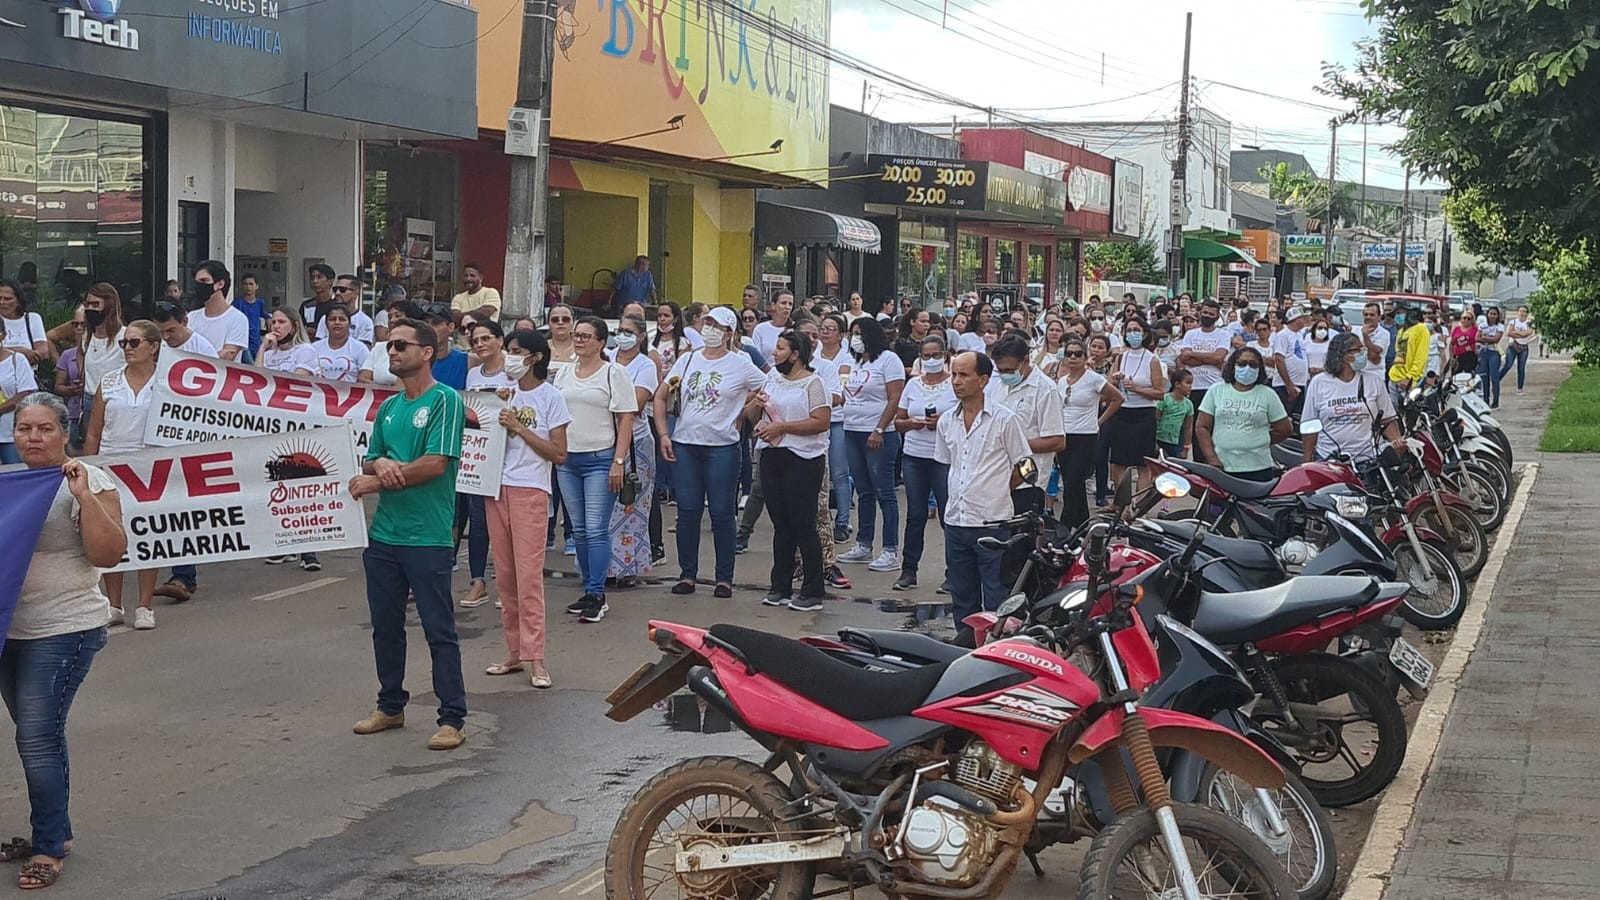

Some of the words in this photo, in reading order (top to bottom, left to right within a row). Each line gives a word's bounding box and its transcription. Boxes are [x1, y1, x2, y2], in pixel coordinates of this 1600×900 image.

[261, 0, 279, 19] EM
[59, 7, 139, 50] Tech
[187, 12, 282, 55] INFORMÁTICA
[881, 164, 922, 184] 20,00
[933, 167, 976, 188] 30,00
[905, 185, 947, 206] 25,00
[160, 402, 281, 434] PROFISSIONAIS
[156, 424, 184, 441] PEDE
[185, 428, 217, 444] APOIO
[130, 506, 246, 536] CUMPRE
[271, 502, 325, 516] Subsede
[328, 500, 344, 511] de
[136, 532, 250, 561] SALARIAL
[1004, 648, 1064, 676] HONDA
[991, 695, 1072, 720] BROS
